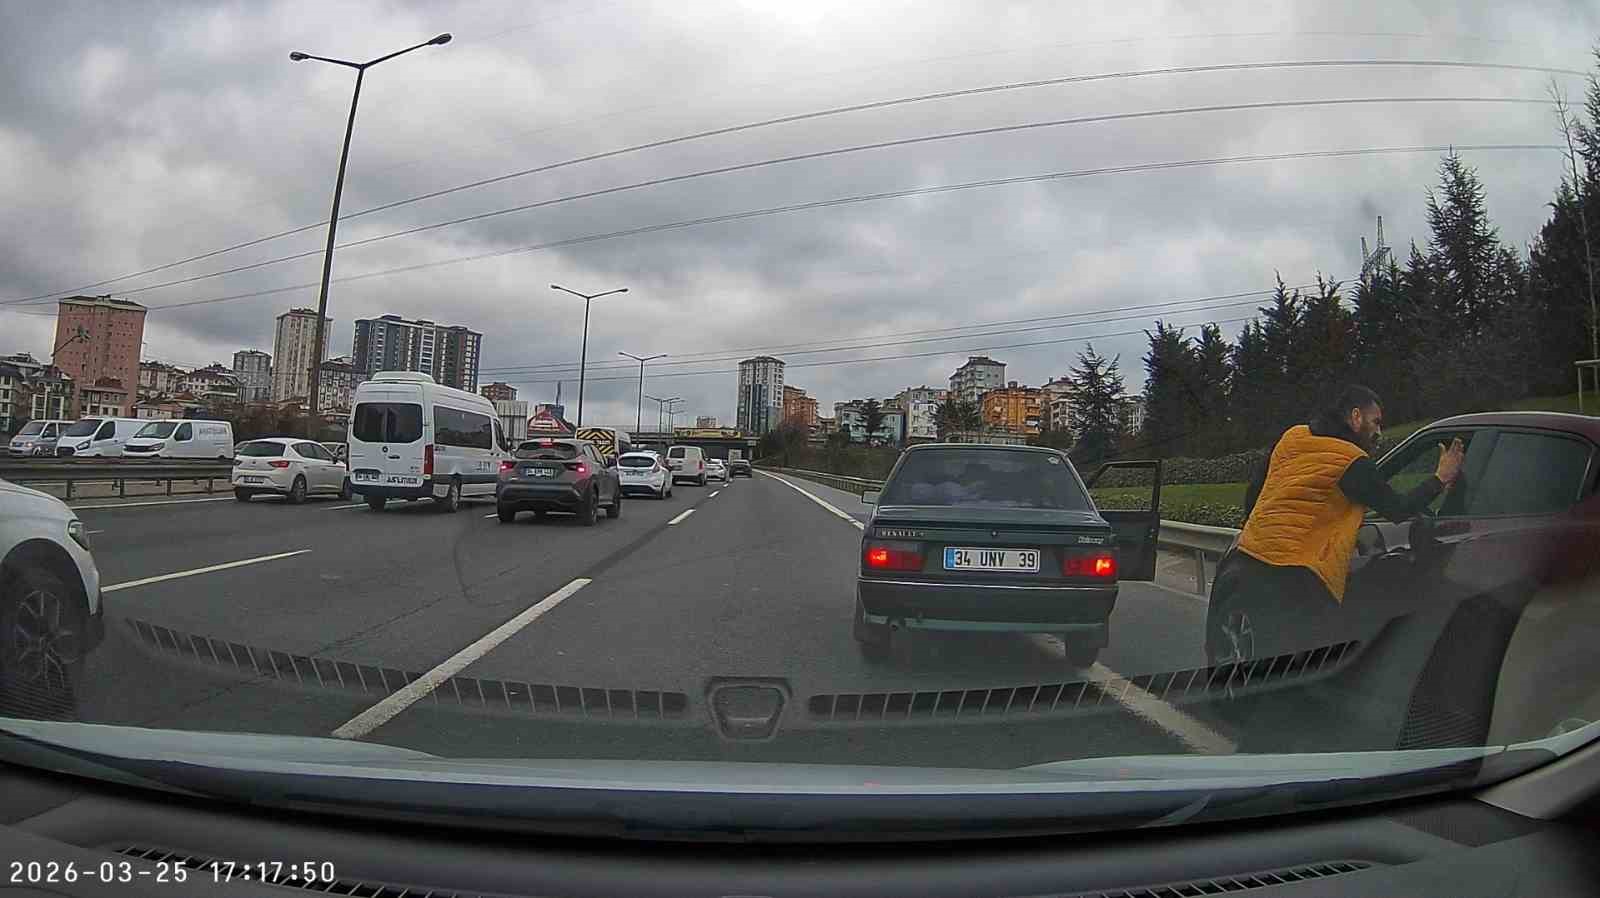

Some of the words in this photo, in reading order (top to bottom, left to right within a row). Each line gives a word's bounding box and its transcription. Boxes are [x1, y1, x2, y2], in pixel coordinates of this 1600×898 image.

[954, 550, 971, 567] 34
[979, 551, 1006, 568] UNV
[1018, 552, 1036, 568] 39
